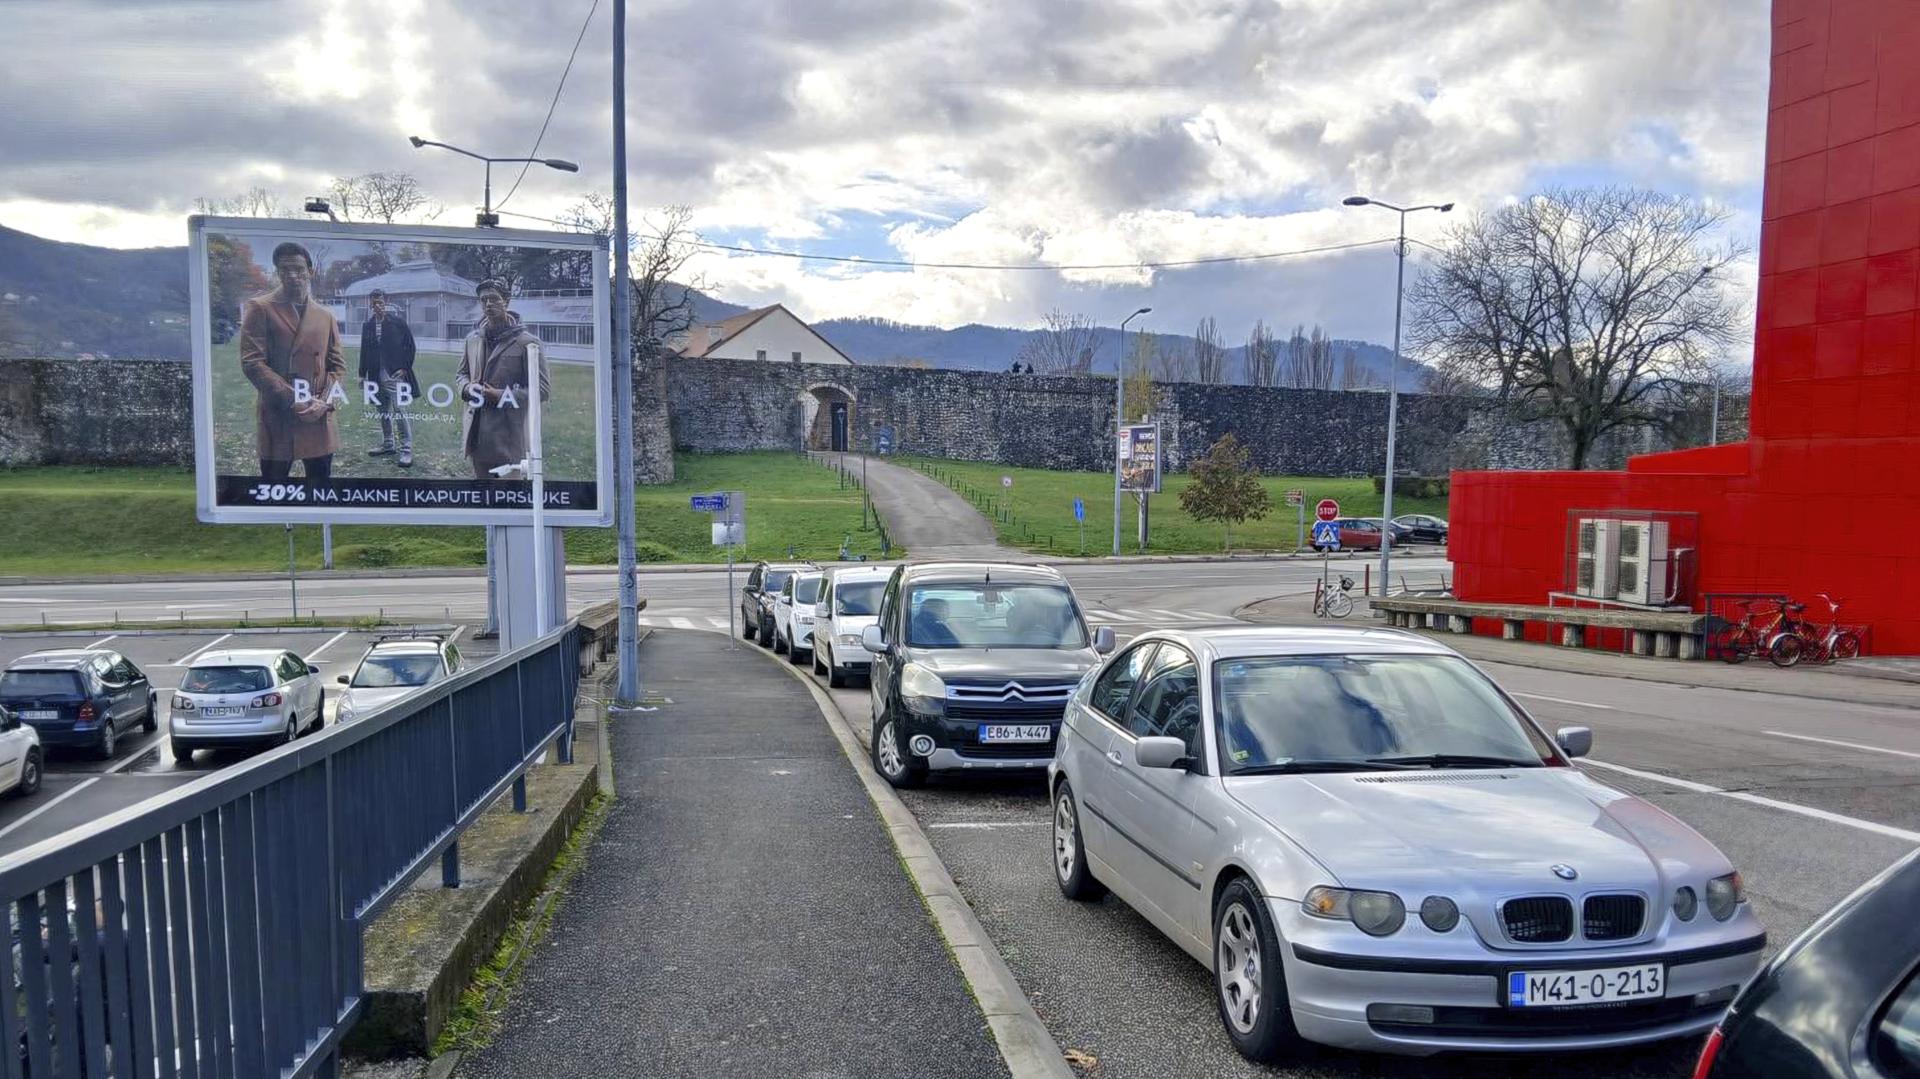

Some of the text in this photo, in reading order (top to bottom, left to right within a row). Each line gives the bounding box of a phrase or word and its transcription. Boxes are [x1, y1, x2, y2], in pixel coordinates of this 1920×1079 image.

[249, 484, 306, 501] -30%
[313, 488, 338, 501] NA
[342, 489, 400, 502] JAKNE
[414, 490, 481, 503] KAPUTE
[1319, 507, 1336, 515] STOP
